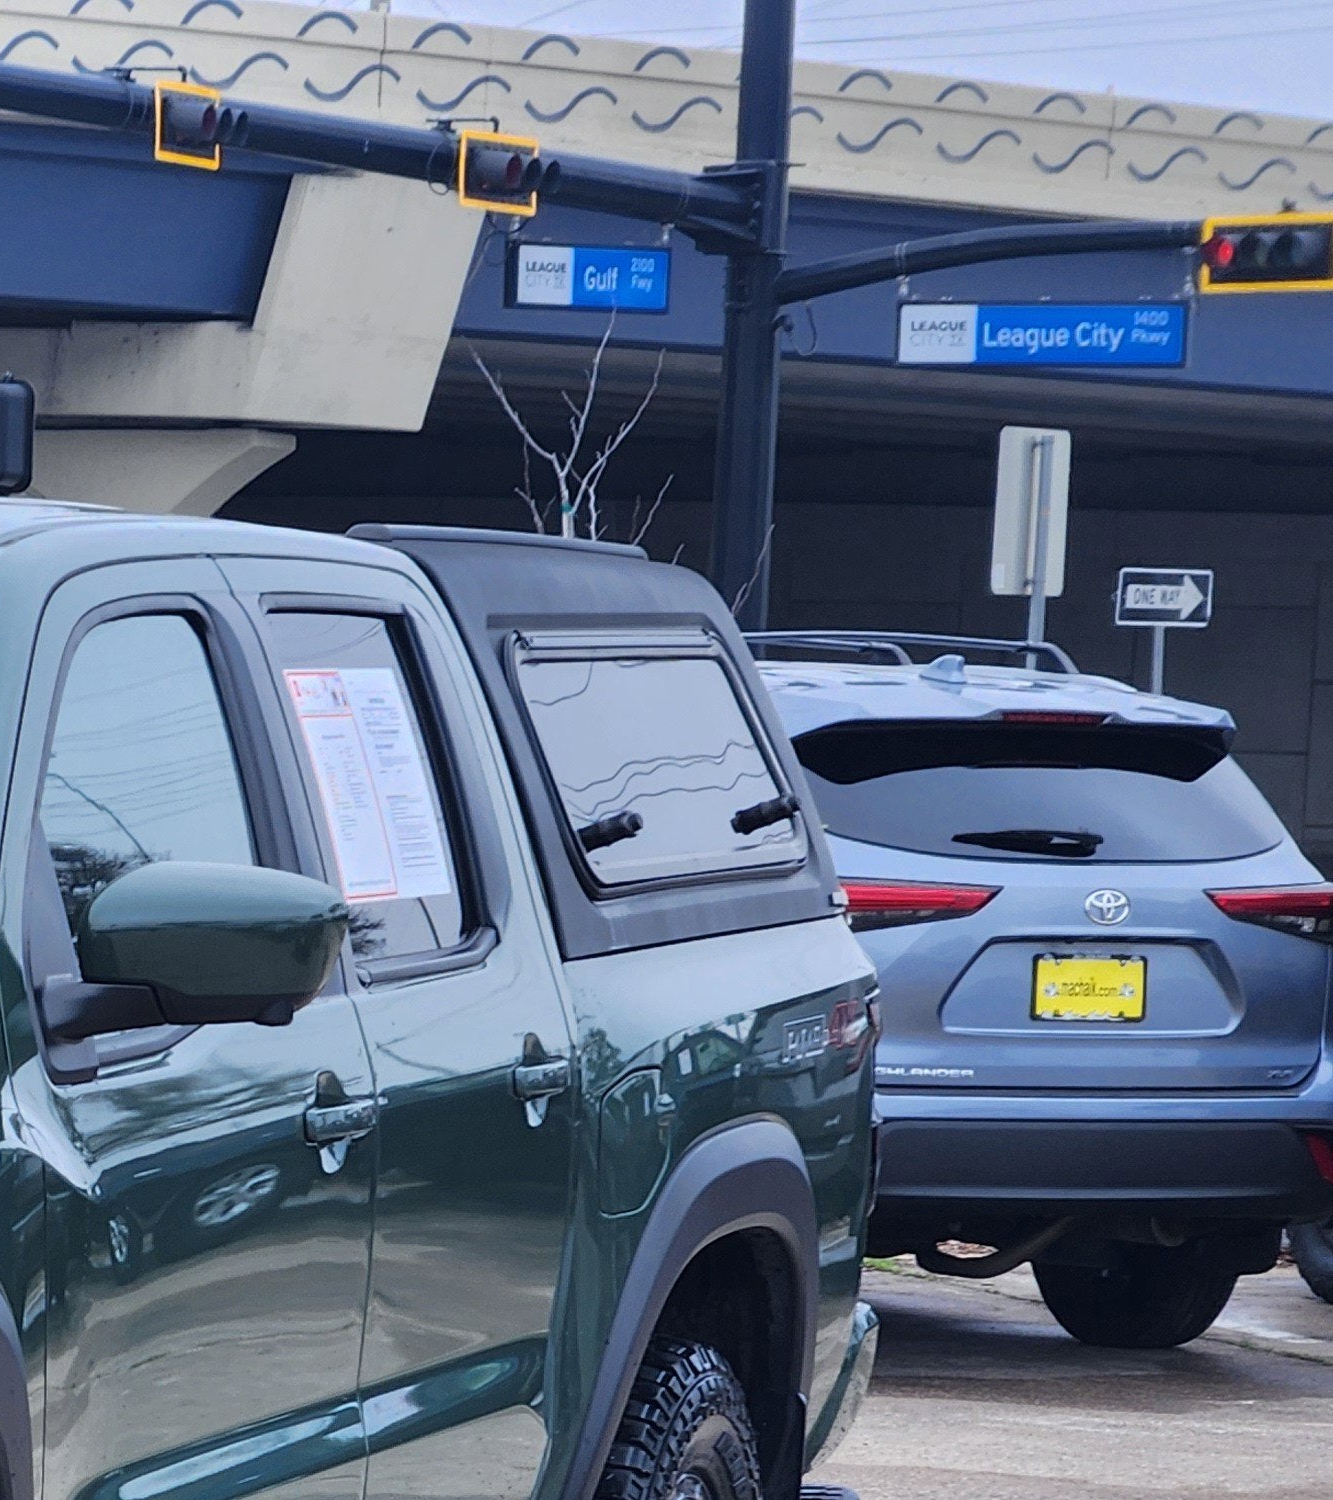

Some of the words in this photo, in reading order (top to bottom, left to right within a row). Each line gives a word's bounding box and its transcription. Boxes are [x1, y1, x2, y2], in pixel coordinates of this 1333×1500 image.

[525, 261, 567, 273] LEAGUE
[584, 265, 619, 292] Gulf
[631, 274, 654, 293] Fwy
[910, 320, 968, 331] LEAGUE
[983, 322, 1071, 355] League
[1073, 321, 1126, 352] City
[1133, 587, 1156, 605] ONE
